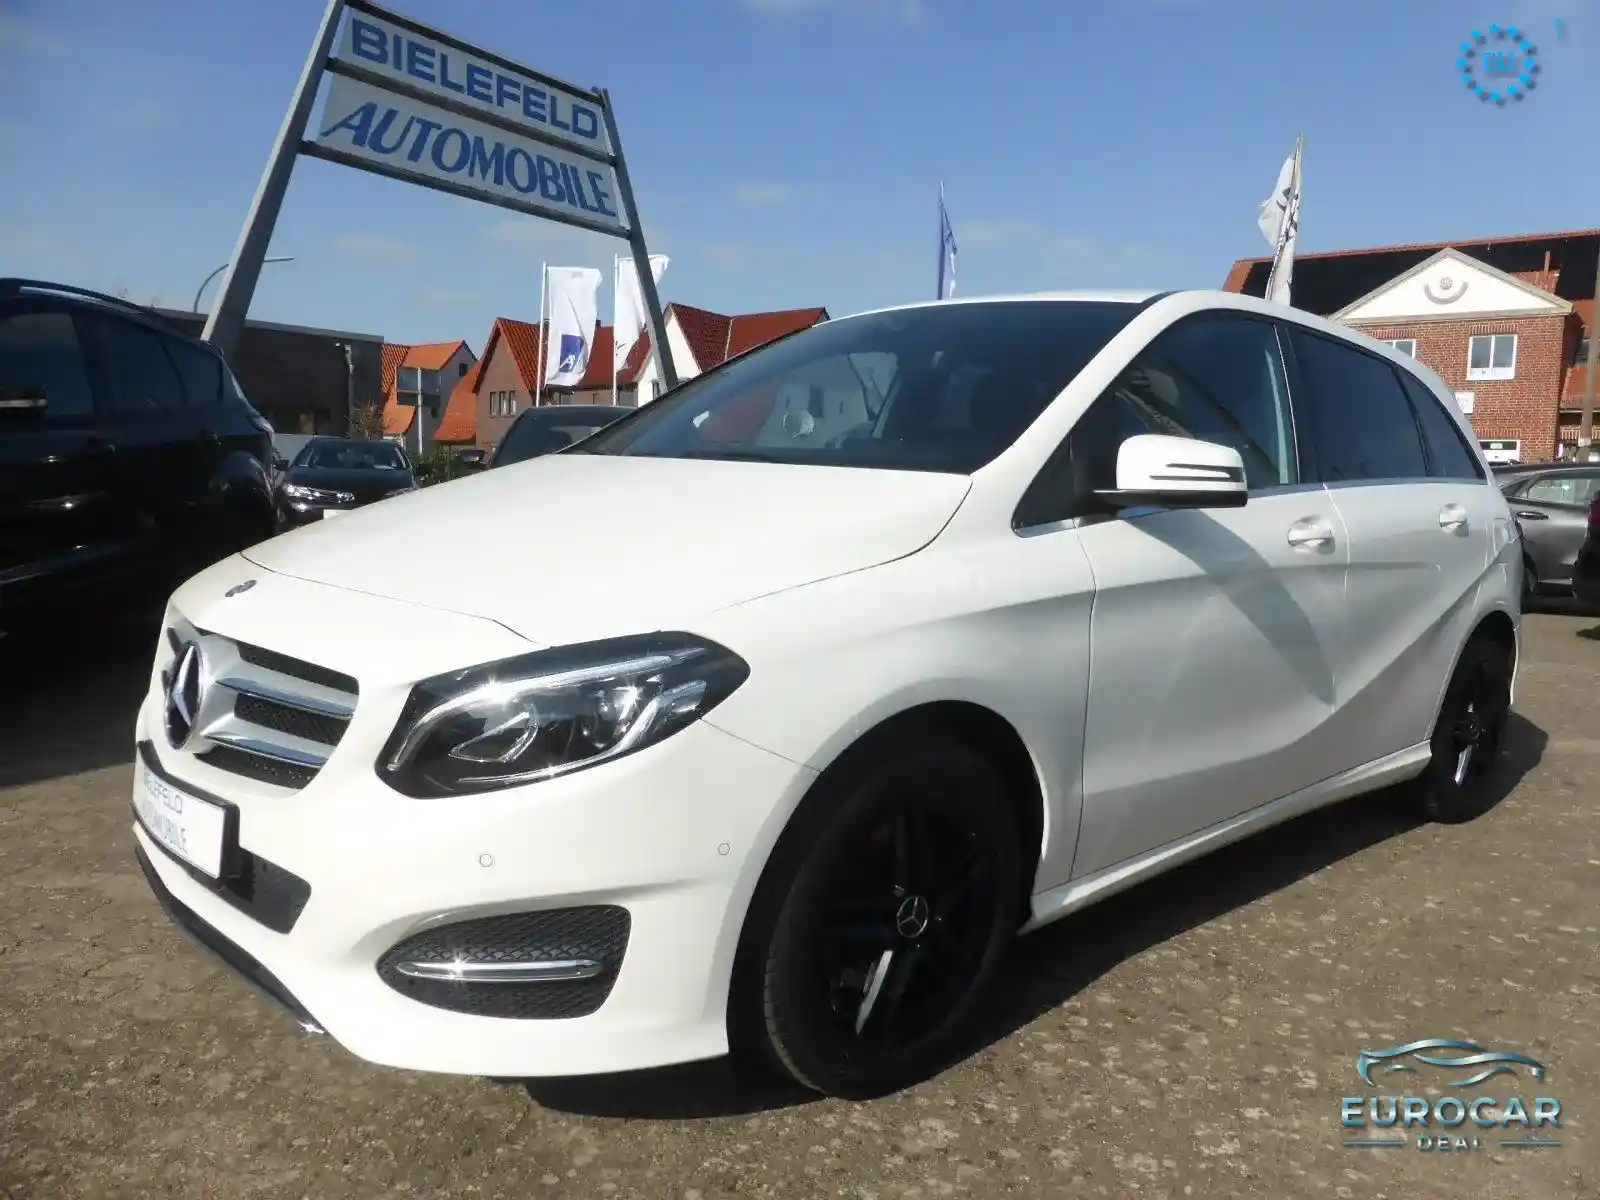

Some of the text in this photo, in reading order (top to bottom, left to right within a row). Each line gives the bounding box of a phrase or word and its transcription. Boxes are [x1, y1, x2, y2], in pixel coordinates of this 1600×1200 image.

[352, 17, 598, 139] BIELEFELD
[319, 101, 617, 217] AUTOMOBILE
[142, 797, 188, 854] TOMOBILE
[143, 771, 183, 814] ELEFELD
